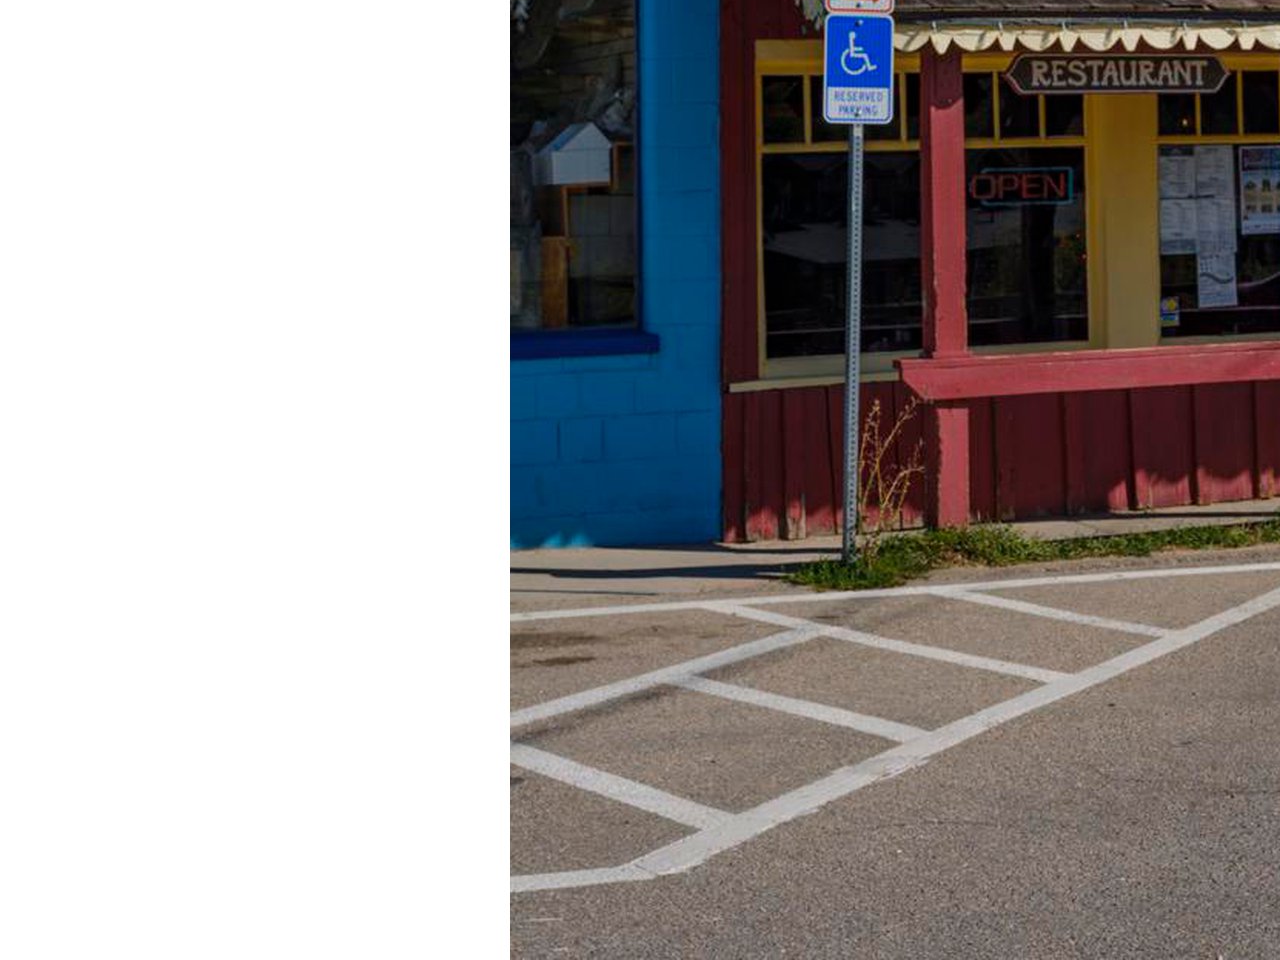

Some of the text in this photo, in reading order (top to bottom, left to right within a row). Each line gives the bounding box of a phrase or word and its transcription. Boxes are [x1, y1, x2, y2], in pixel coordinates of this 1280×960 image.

[1030, 60, 1208, 87] RESTAURANT
[834, 90, 883, 102] RESERVED
[838, 105, 880, 117] PARKING
[970, 173, 1065, 199] OPEN
